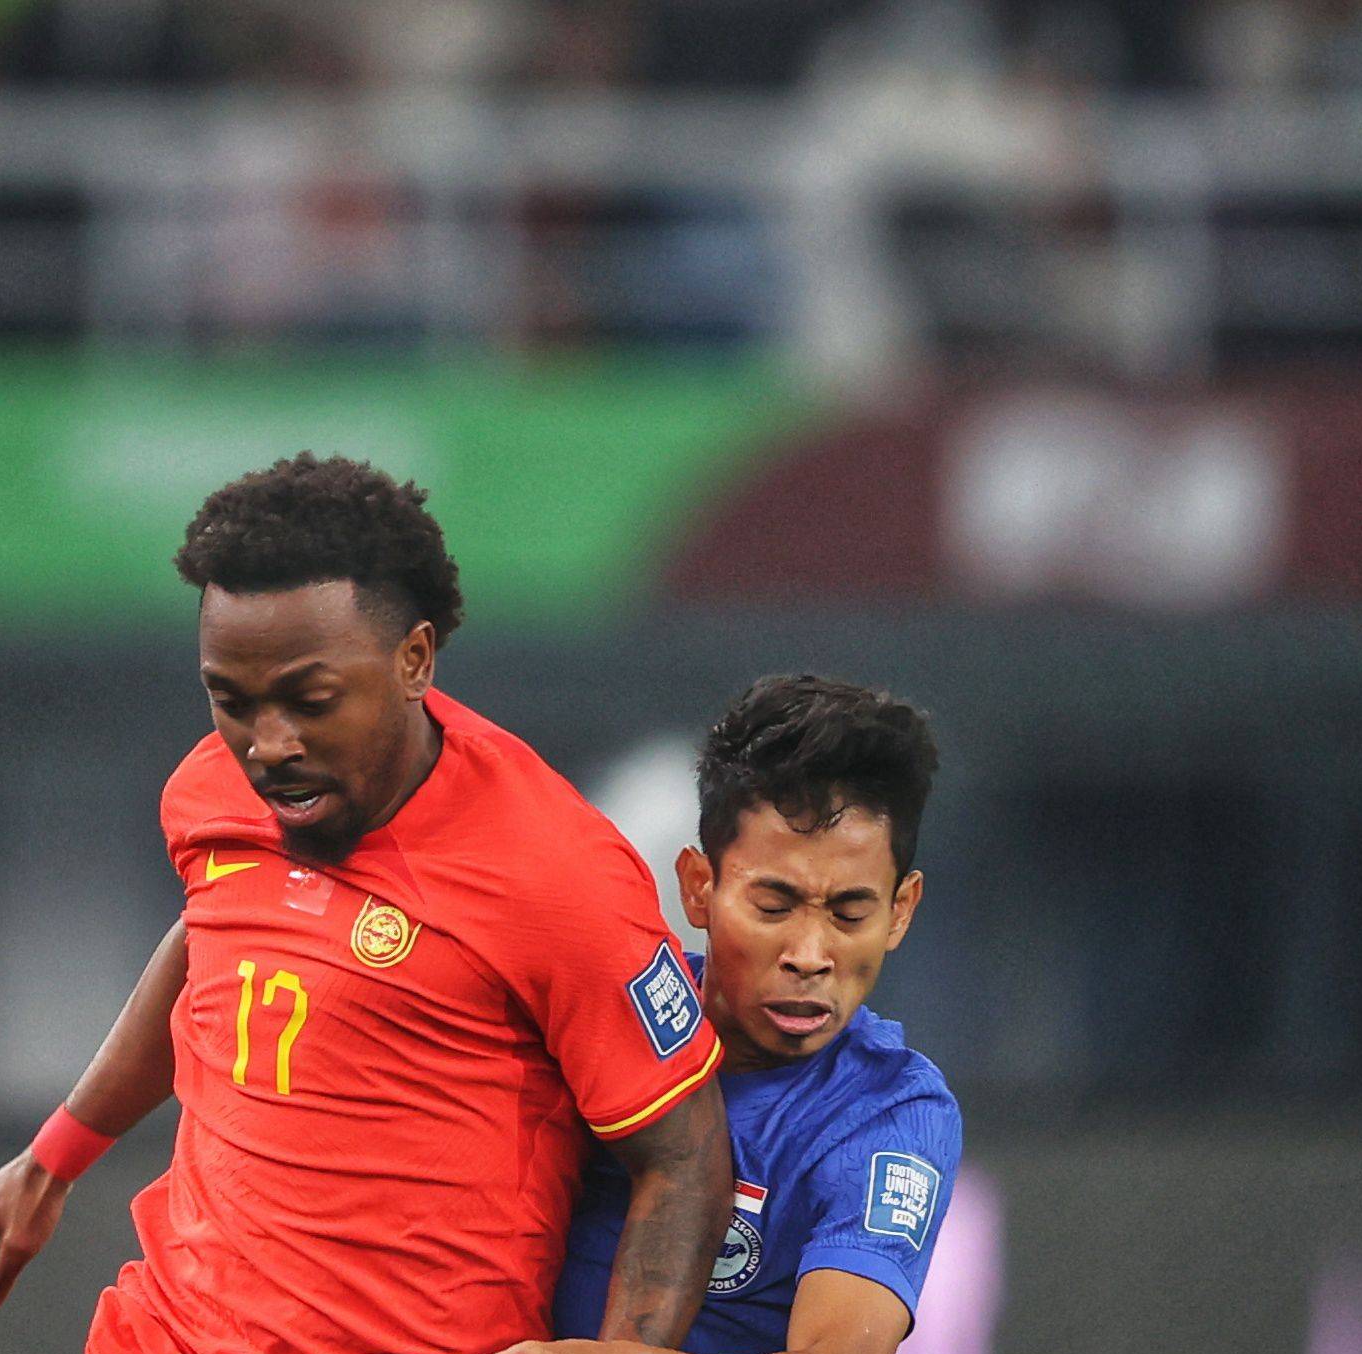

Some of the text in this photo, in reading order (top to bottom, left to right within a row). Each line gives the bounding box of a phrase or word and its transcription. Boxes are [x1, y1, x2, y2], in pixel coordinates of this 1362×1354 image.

[232, 960, 308, 1096] 17
[885, 1174, 929, 1204] UNITES
[886, 1162, 929, 1188] FOOTBALL
[732, 1217, 760, 1273] SSOCIATION
